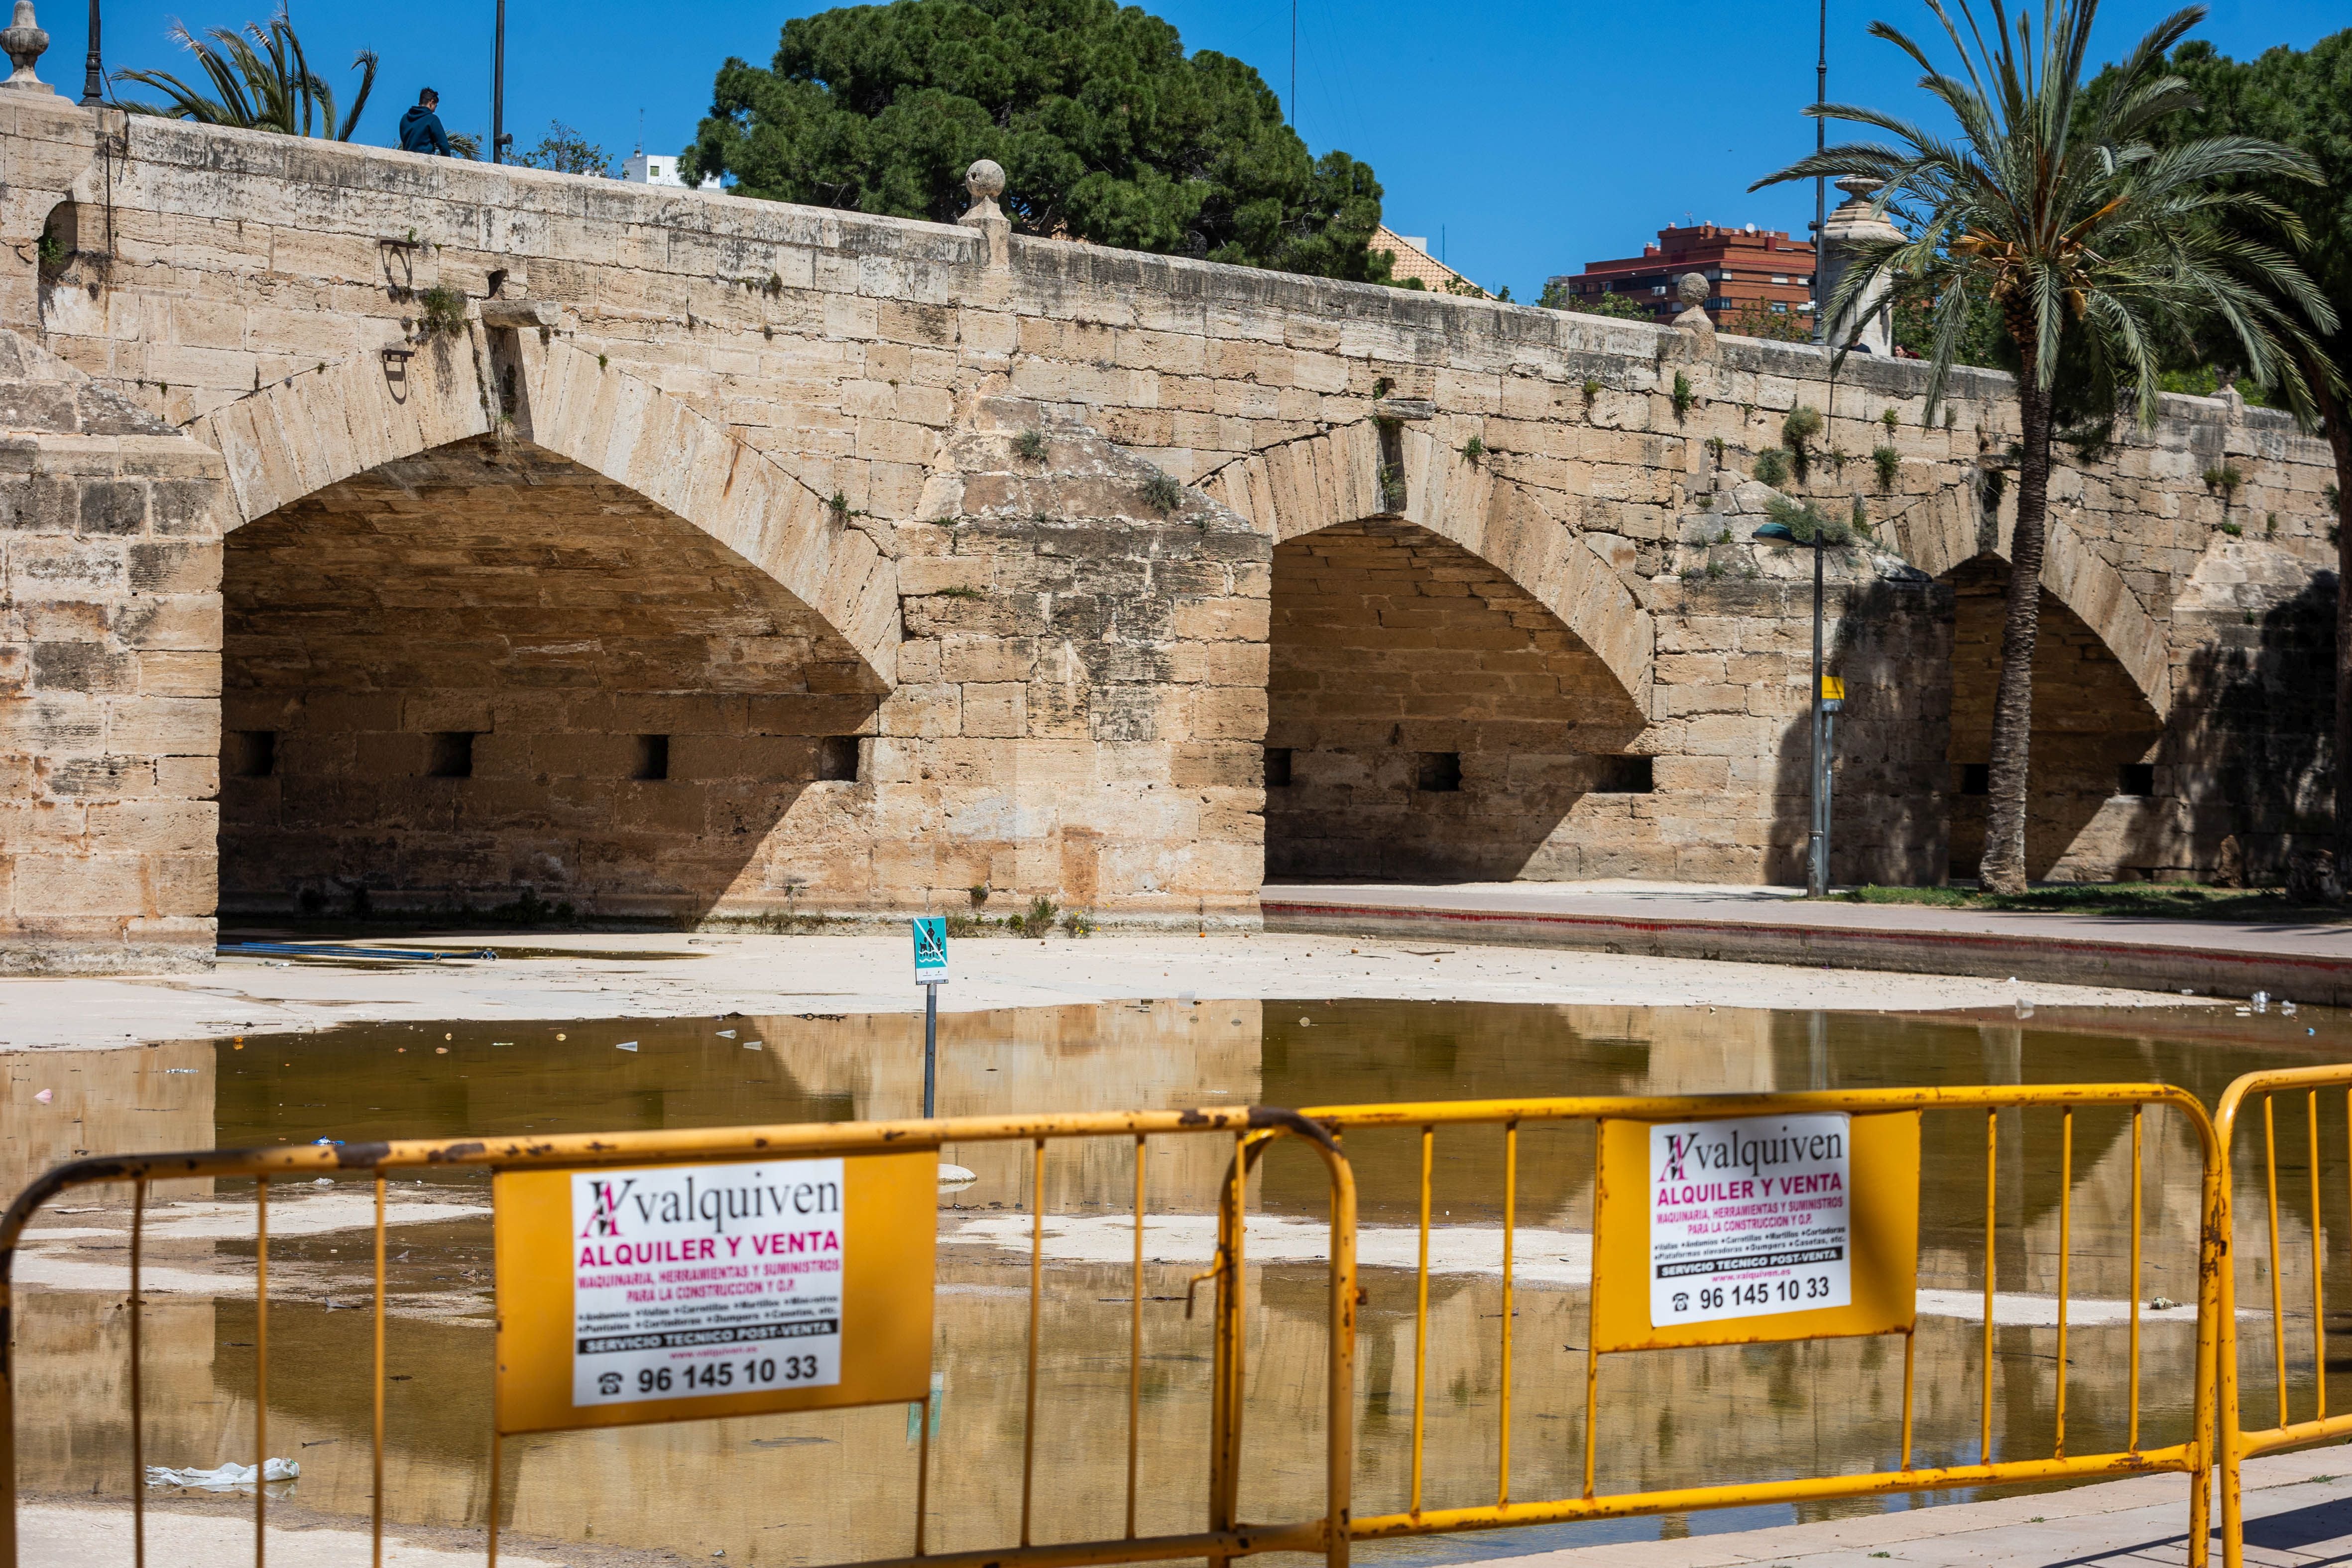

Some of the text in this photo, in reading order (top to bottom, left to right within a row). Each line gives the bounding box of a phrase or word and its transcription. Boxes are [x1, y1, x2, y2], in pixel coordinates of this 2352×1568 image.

[1695, 1126, 1843, 1177] valquiven
[634, 1172, 838, 1233] valquiven
[1657, 1173, 1842, 1206] ALQUILER Y VENTA
[1657, 1196, 1843, 1225] MAQUINARIA, HERRAMIENTAS Y SUMINISTROS
[1688, 1223, 1709, 1235] PARA
[1712, 1221, 1721, 1233] LA
[1724, 1215, 1788, 1231] CONSTRUCCION
[1791, 1215, 1796, 1226] Y
[580, 1230, 838, 1268] ALQUILER Y VENTA
[1661, 1249, 1838, 1277] SERVICIO TECNICO POST-VENTA
[578, 1259, 839, 1288] MAQUINARIA, HERRAMIENTAS Y SUMINISTROS
[1712, 1269, 1791, 1282] www.valquiven.es
[627, 1290, 655, 1303] PARA
[659, 1288, 672, 1301] LA
[677, 1281, 762, 1299] CONSTRUCCION
[767, 1281, 773, 1292] Y
[1701, 1276, 1829, 1309] 96 145 10 33
[586, 1321, 831, 1353] SERVICIO TECNICO POST-VENTA
[638, 1354, 818, 1392] 96 145 10 33
